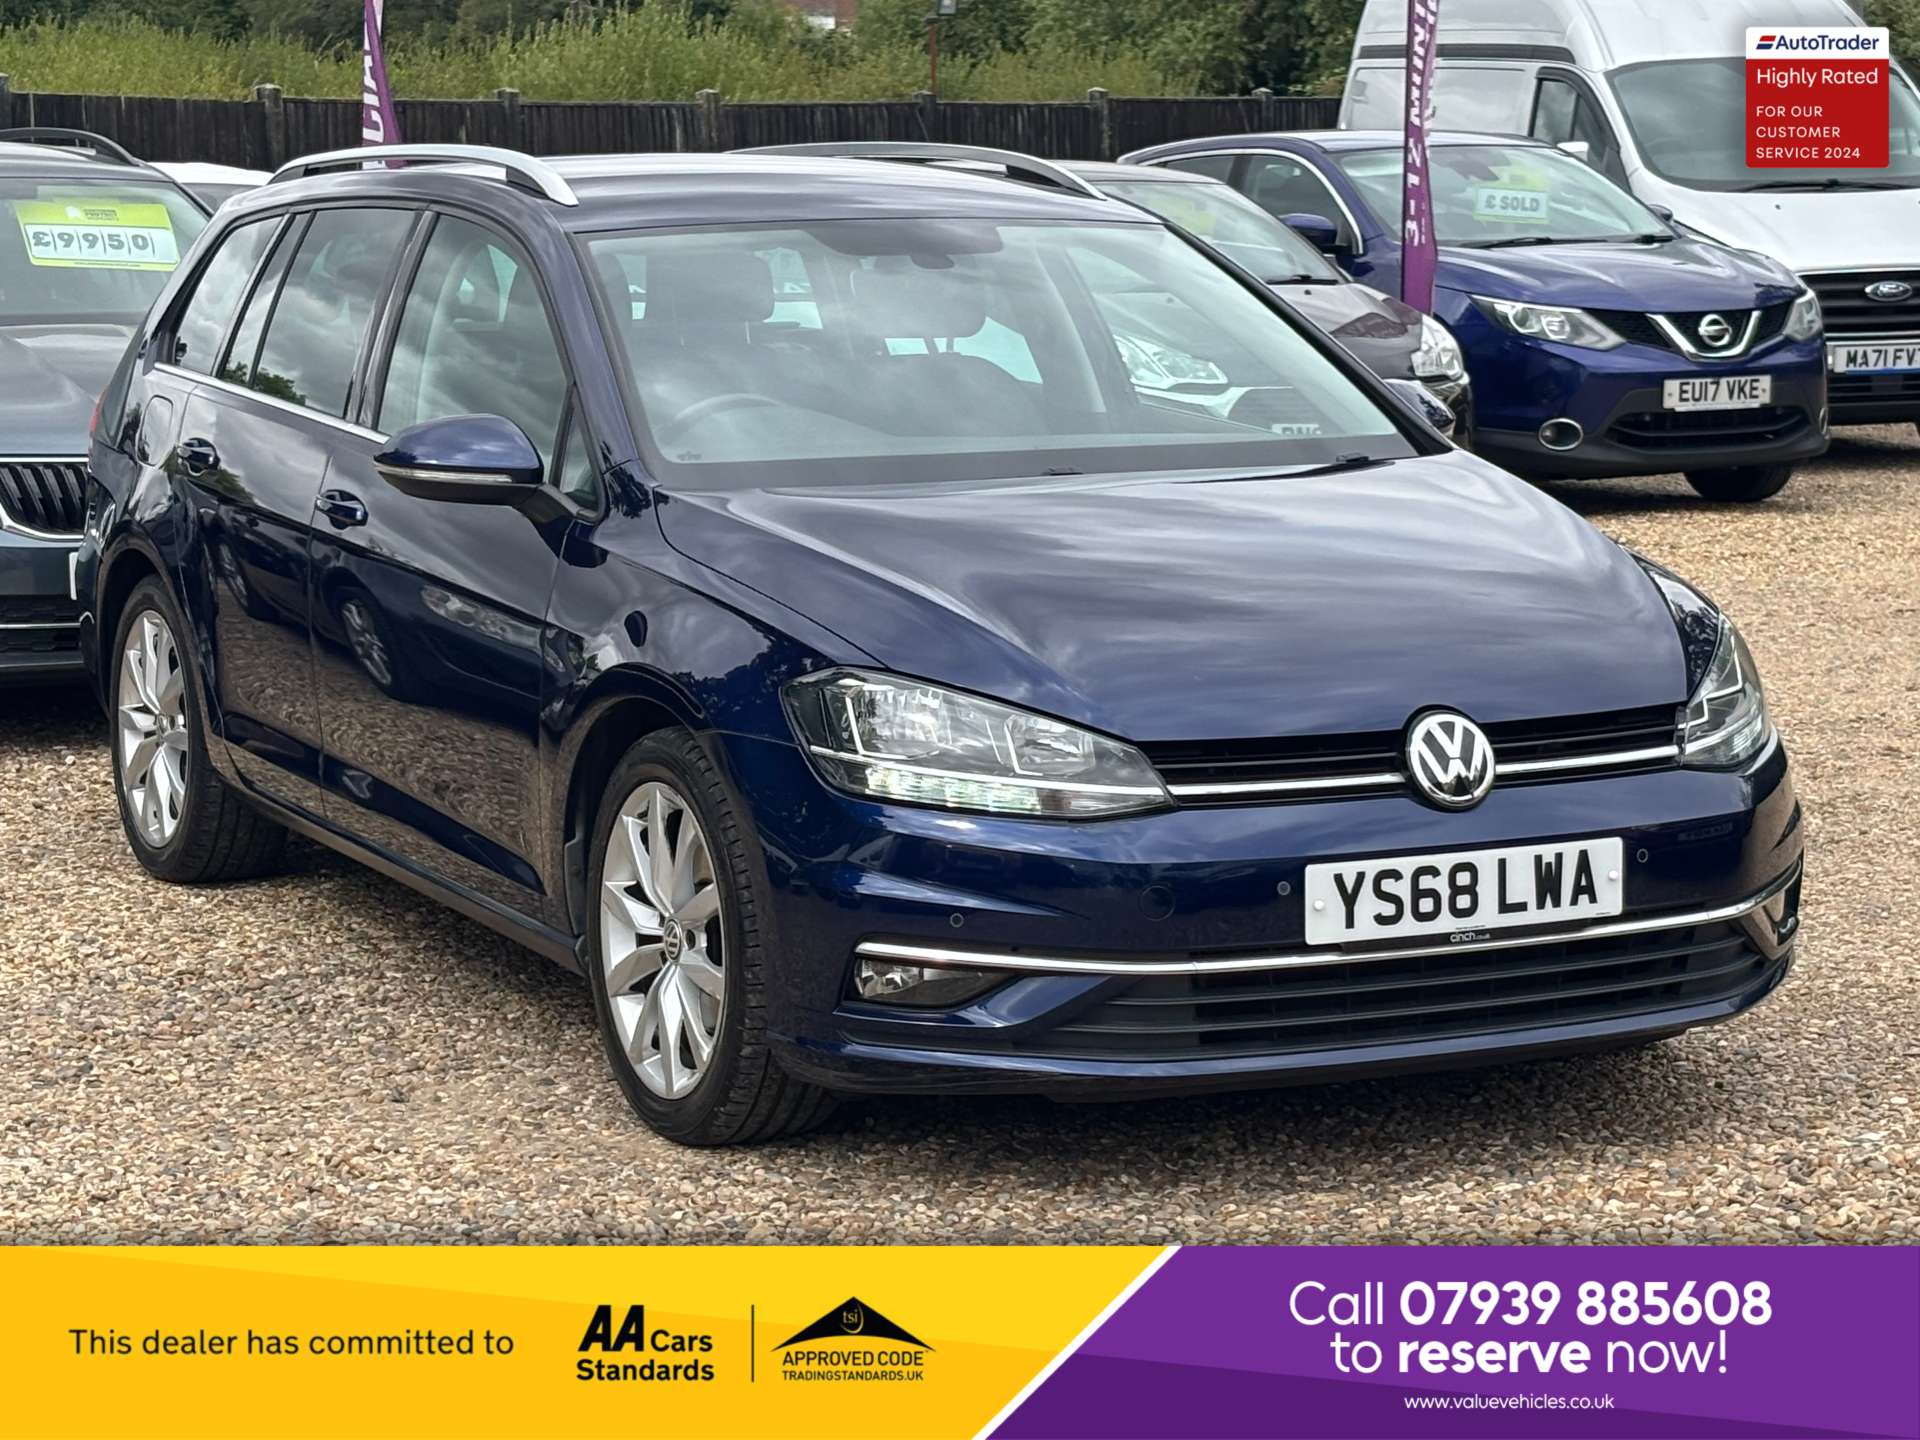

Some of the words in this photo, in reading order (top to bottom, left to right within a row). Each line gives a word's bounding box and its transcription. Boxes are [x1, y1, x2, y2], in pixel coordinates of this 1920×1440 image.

[1500, 195, 1540, 213] SOLD
[1846, 349, 1889, 369] MA71
[1892, 346, 1920, 368] FV
[1678, 381, 1721, 403] EU17
[1726, 379, 1761, 401] VKE
[1333, 861, 1479, 930] YS68
[1498, 849, 1598, 915] LWA
